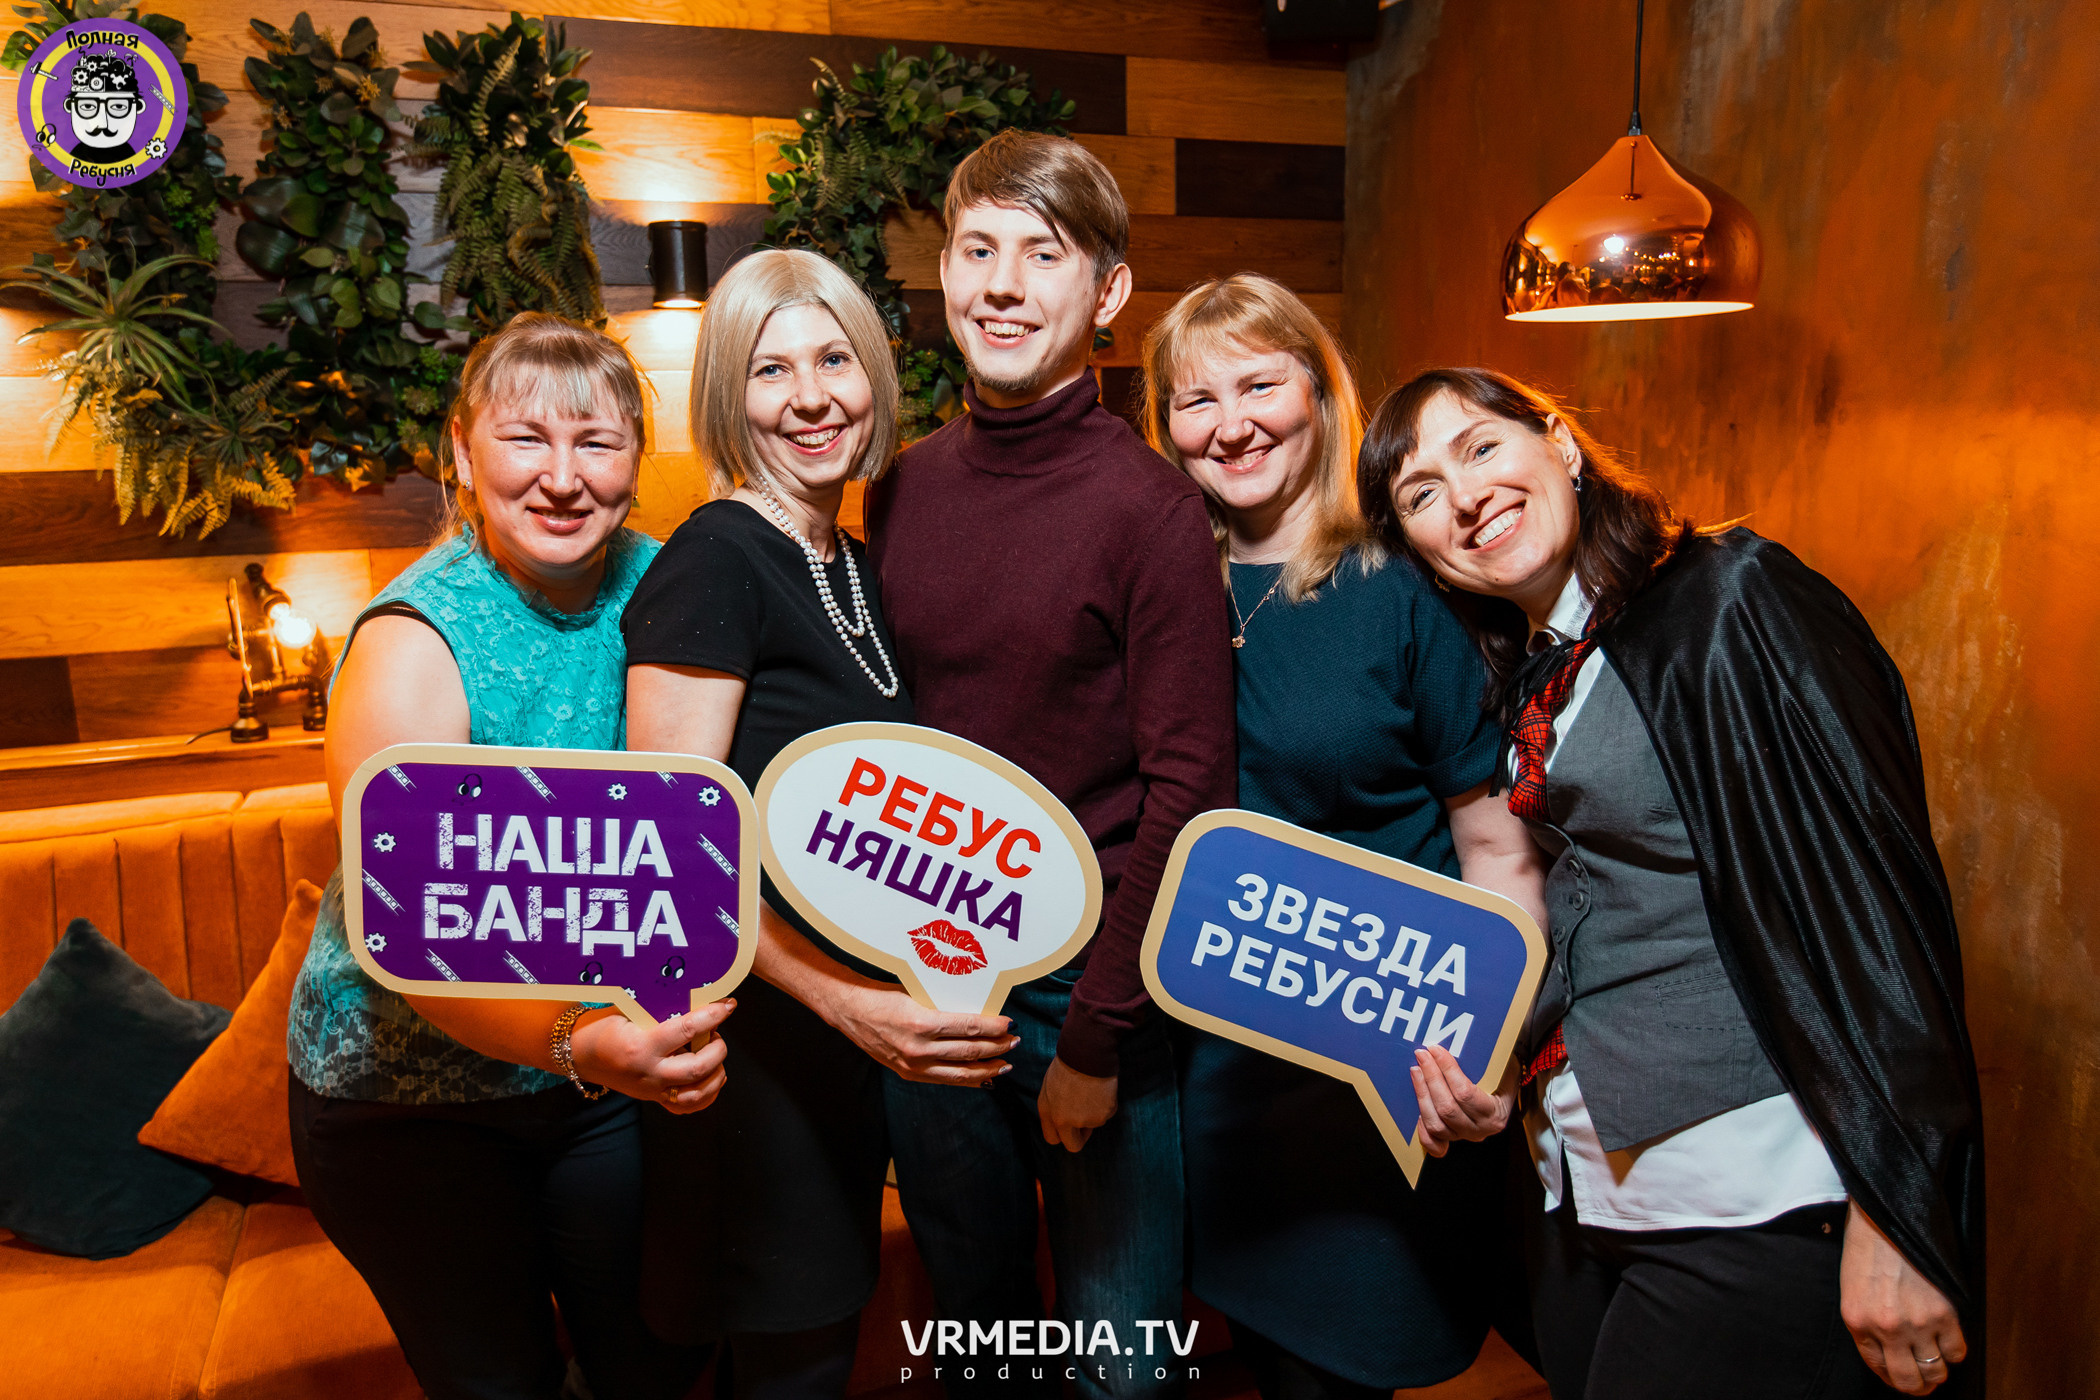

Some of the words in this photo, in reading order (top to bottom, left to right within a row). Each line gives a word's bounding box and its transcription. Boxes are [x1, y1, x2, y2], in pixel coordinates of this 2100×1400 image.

[438, 812, 674, 877] НАША
[805, 809, 1023, 942] НЯШКА
[838, 757, 1042, 879] РЕБУС
[423, 882, 689, 957] БАНДА
[1227, 873, 1467, 996] ЗВЕЗДА
[1190, 921, 1475, 1059] РЕБУСНИ
